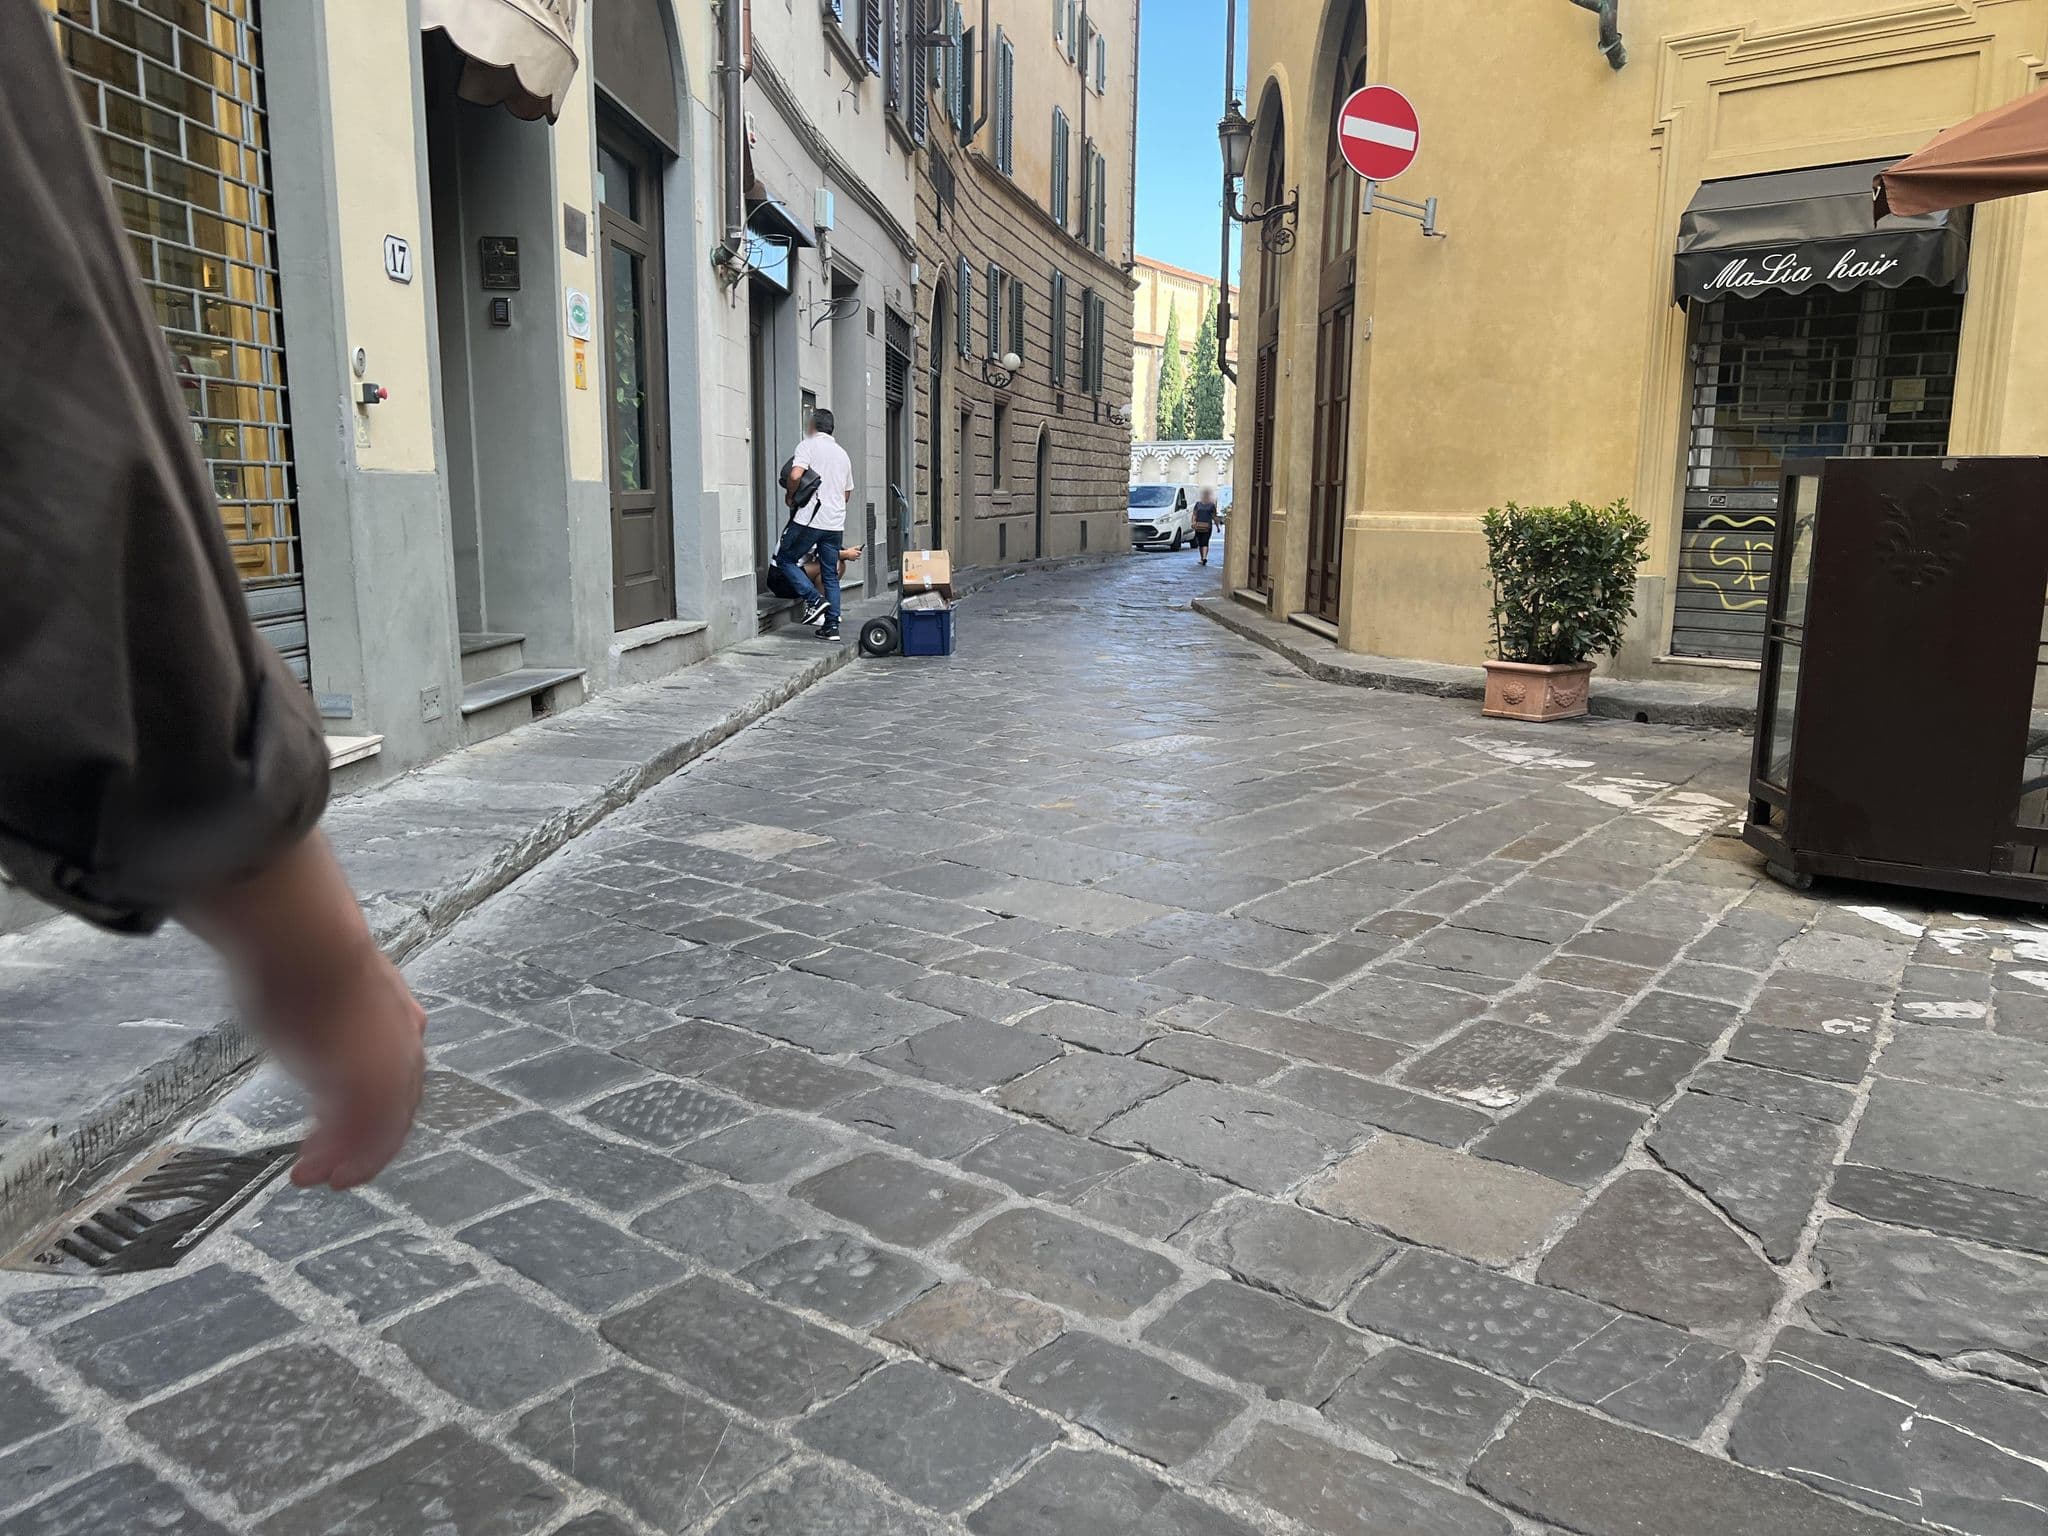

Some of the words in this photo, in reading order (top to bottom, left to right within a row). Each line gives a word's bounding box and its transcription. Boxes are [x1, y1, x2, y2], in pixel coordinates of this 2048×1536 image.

[391, 243, 407, 274] 17
[1703, 254, 1812, 290] MaLia
[1827, 249, 1898, 280] hair
